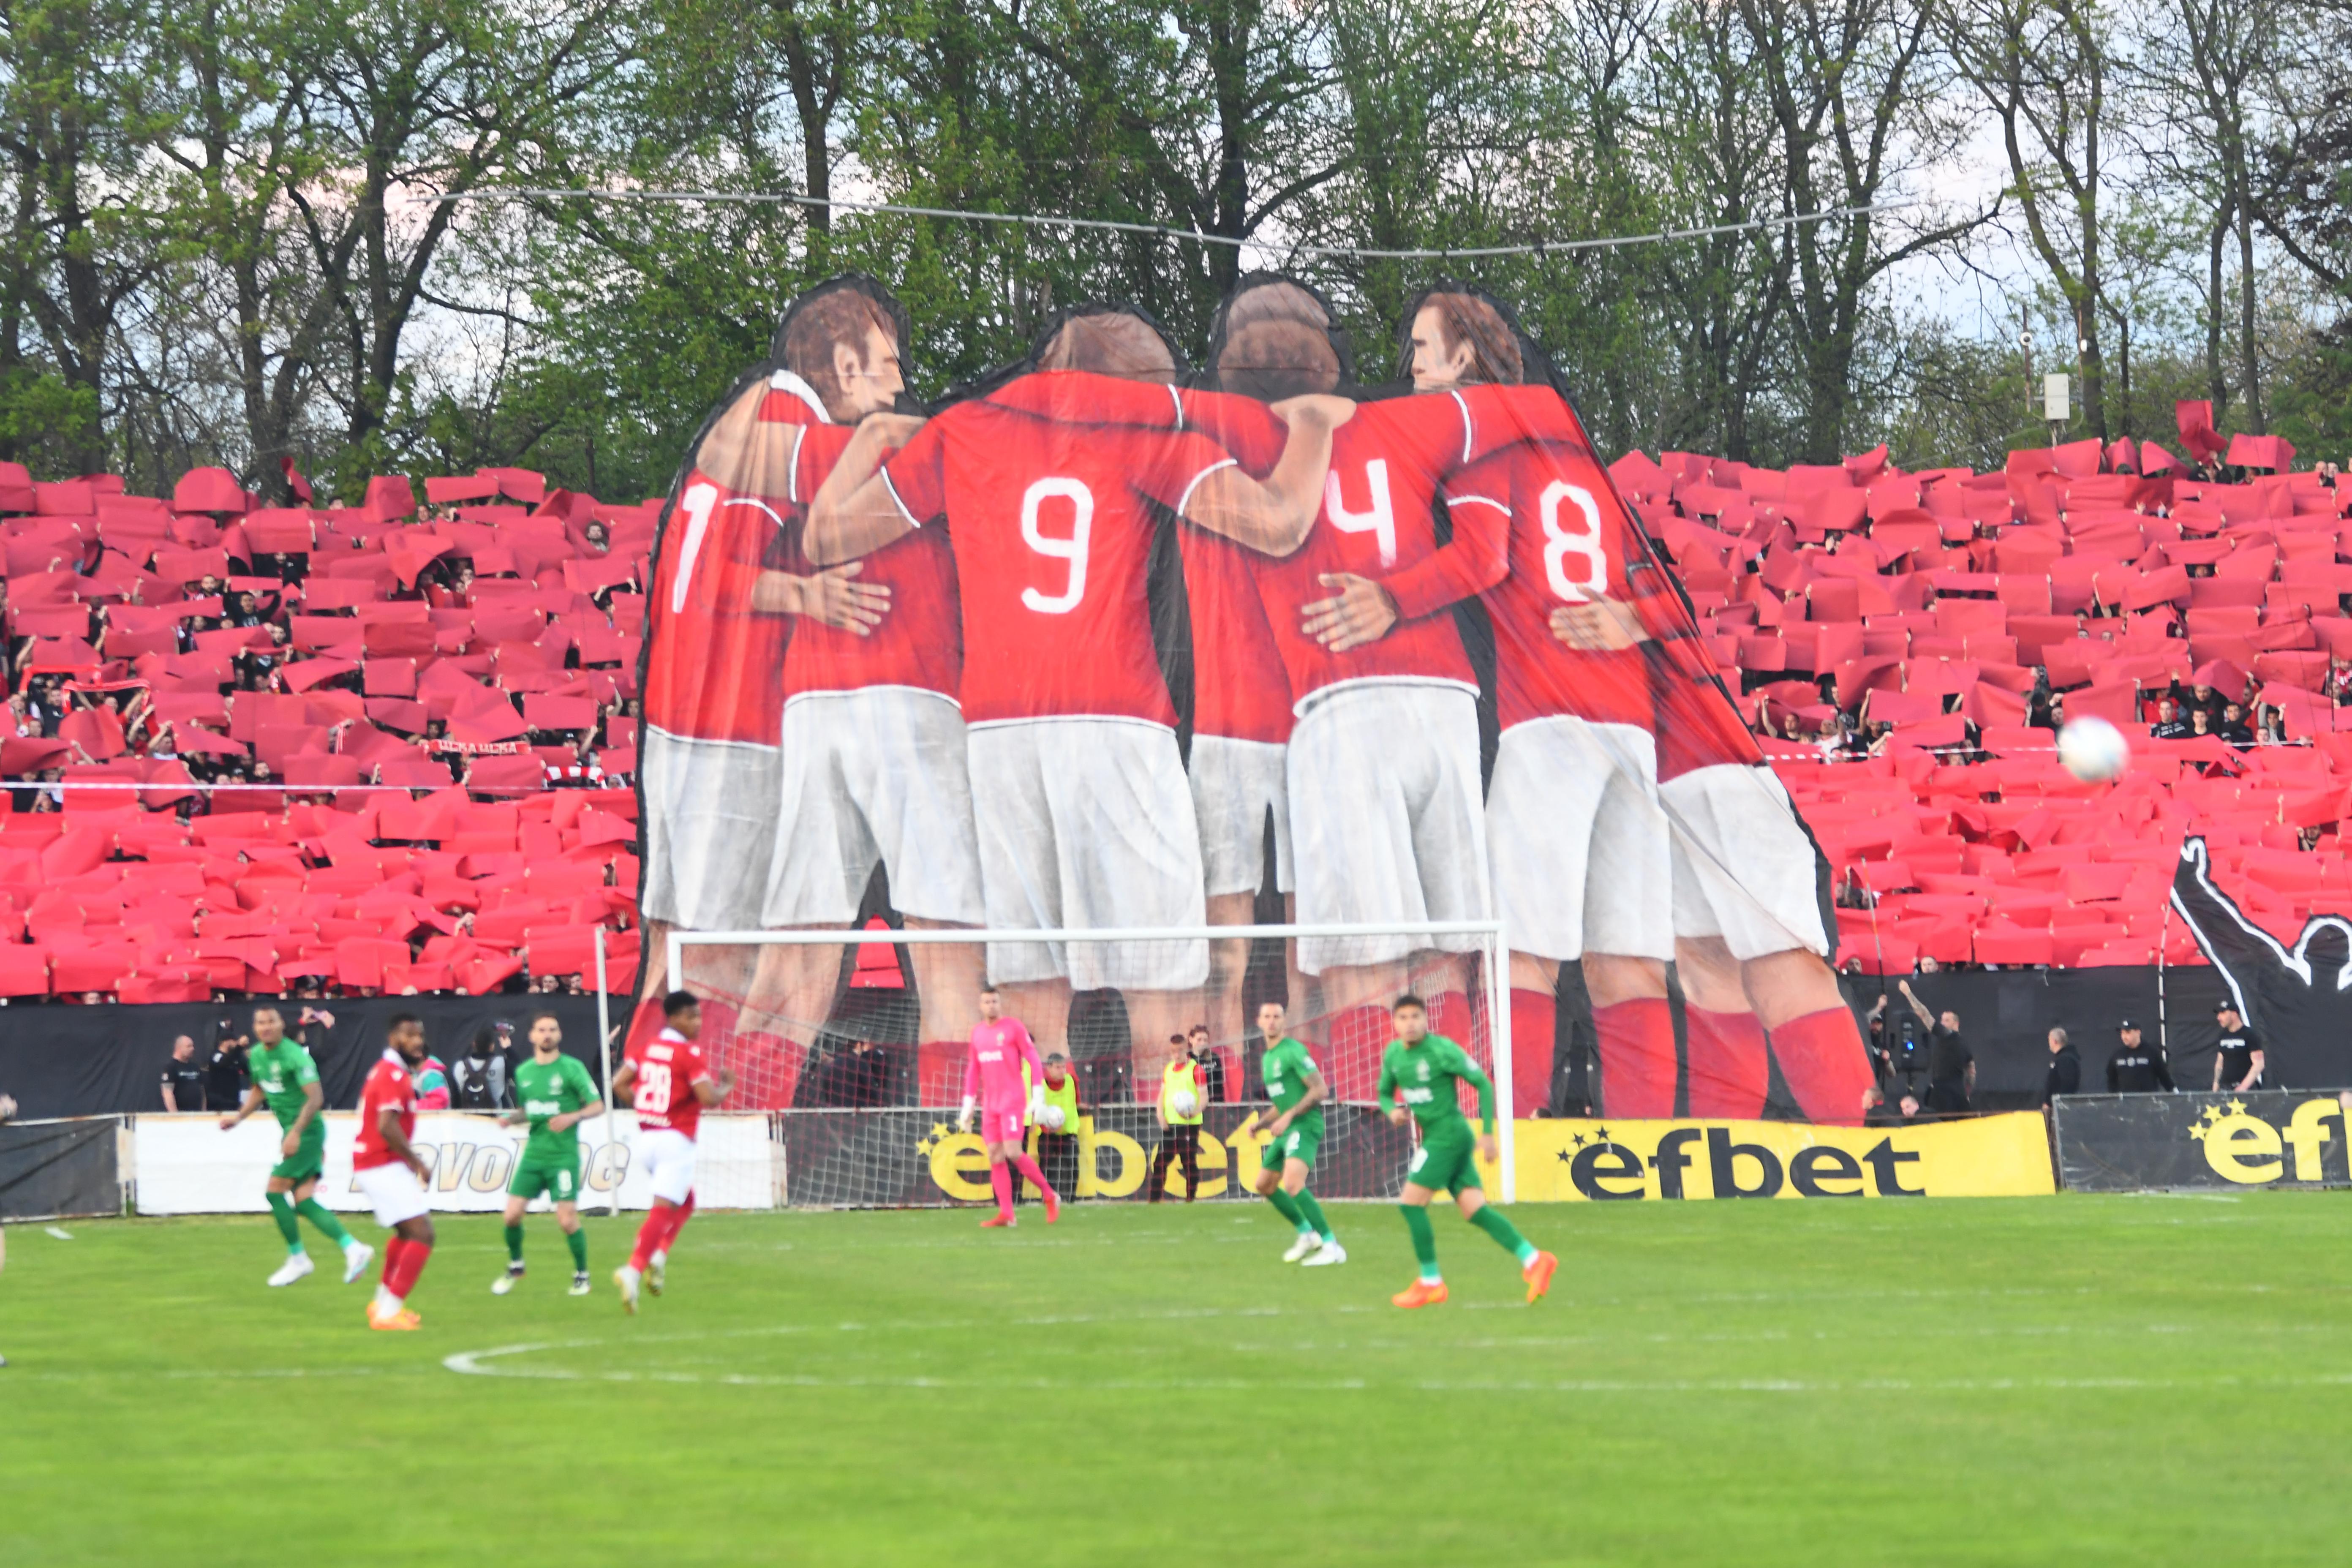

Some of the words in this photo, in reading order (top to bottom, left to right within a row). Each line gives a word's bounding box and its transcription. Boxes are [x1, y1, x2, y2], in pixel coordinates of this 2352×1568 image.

[672, 483, 718, 613] 1
[1021, 477, 1094, 614] 9
[1326, 459, 1396, 569] 4
[1540, 479, 1608, 602] 8
[635, 1061, 672, 1114] 28
[1010, 1115, 1018, 1132] 1
[931, 1110, 1287, 1201] ebet
[1571, 1127, 1925, 1200] efbet
[2203, 1098, 2352, 1184] ef
